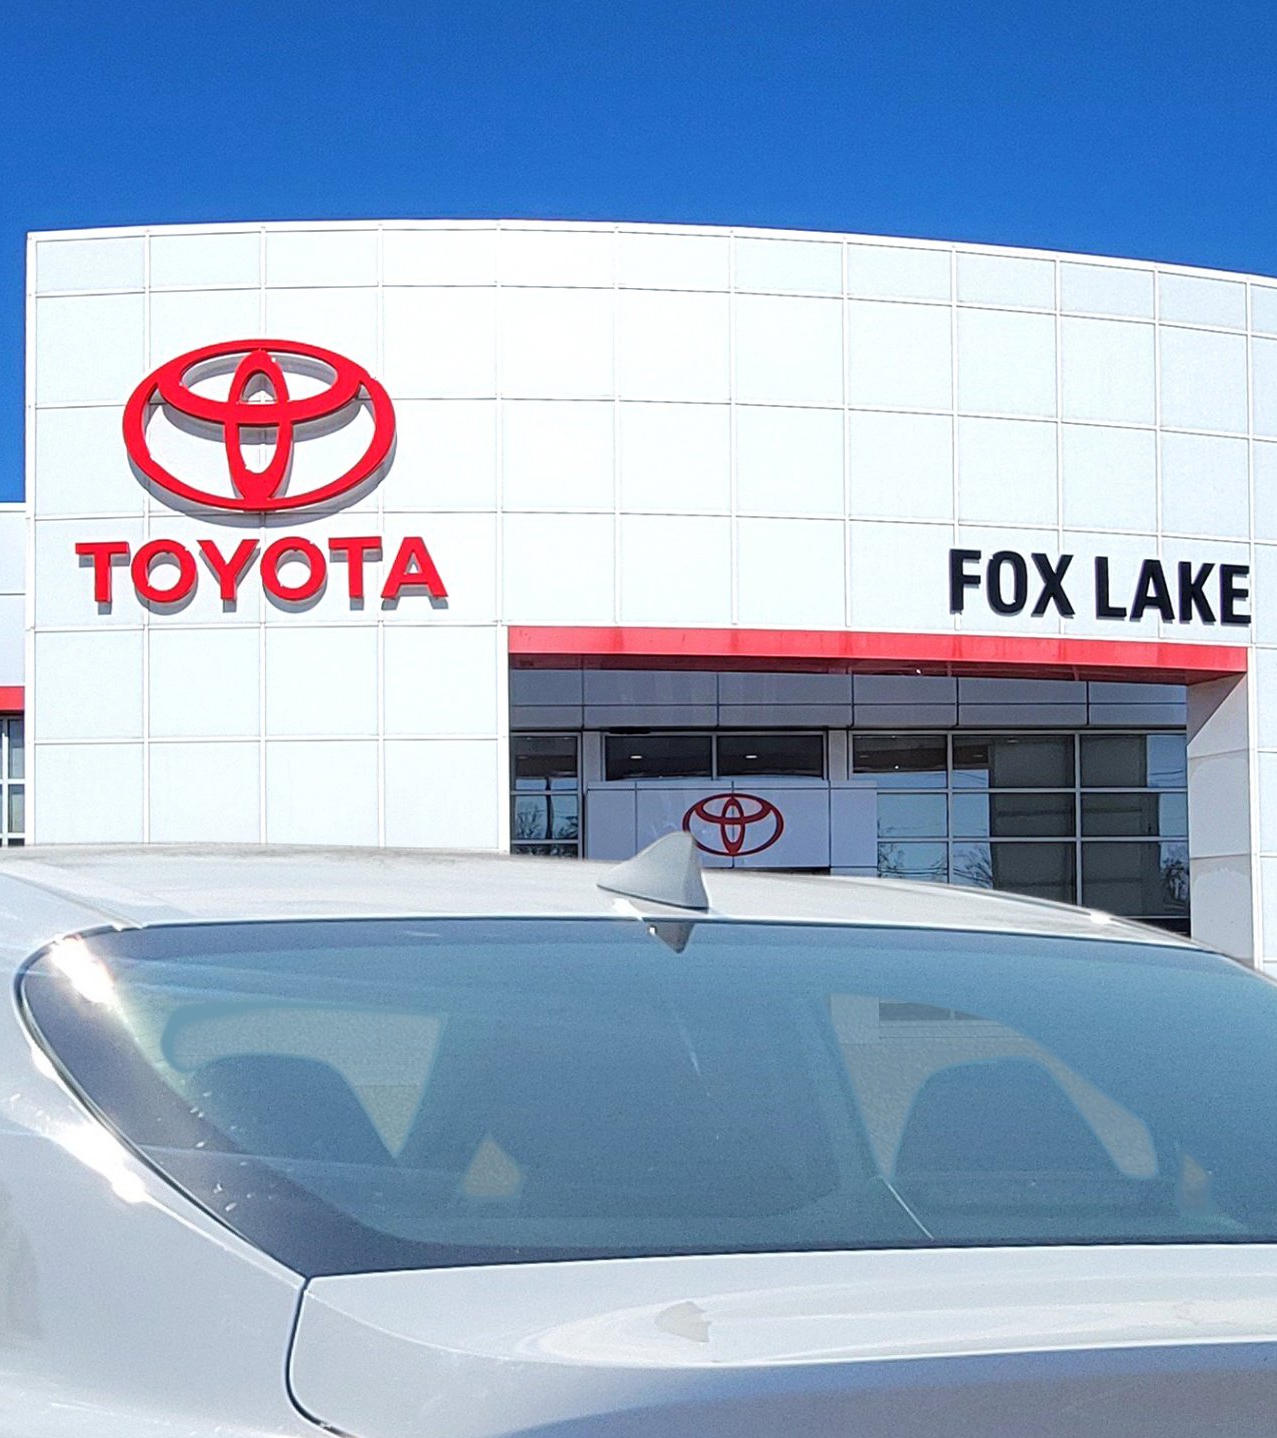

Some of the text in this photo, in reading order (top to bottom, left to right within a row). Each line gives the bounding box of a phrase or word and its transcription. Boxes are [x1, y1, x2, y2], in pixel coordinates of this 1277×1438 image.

[75, 536, 448, 606] TOYOTA
[949, 549, 1252, 626] FOX LAKE
